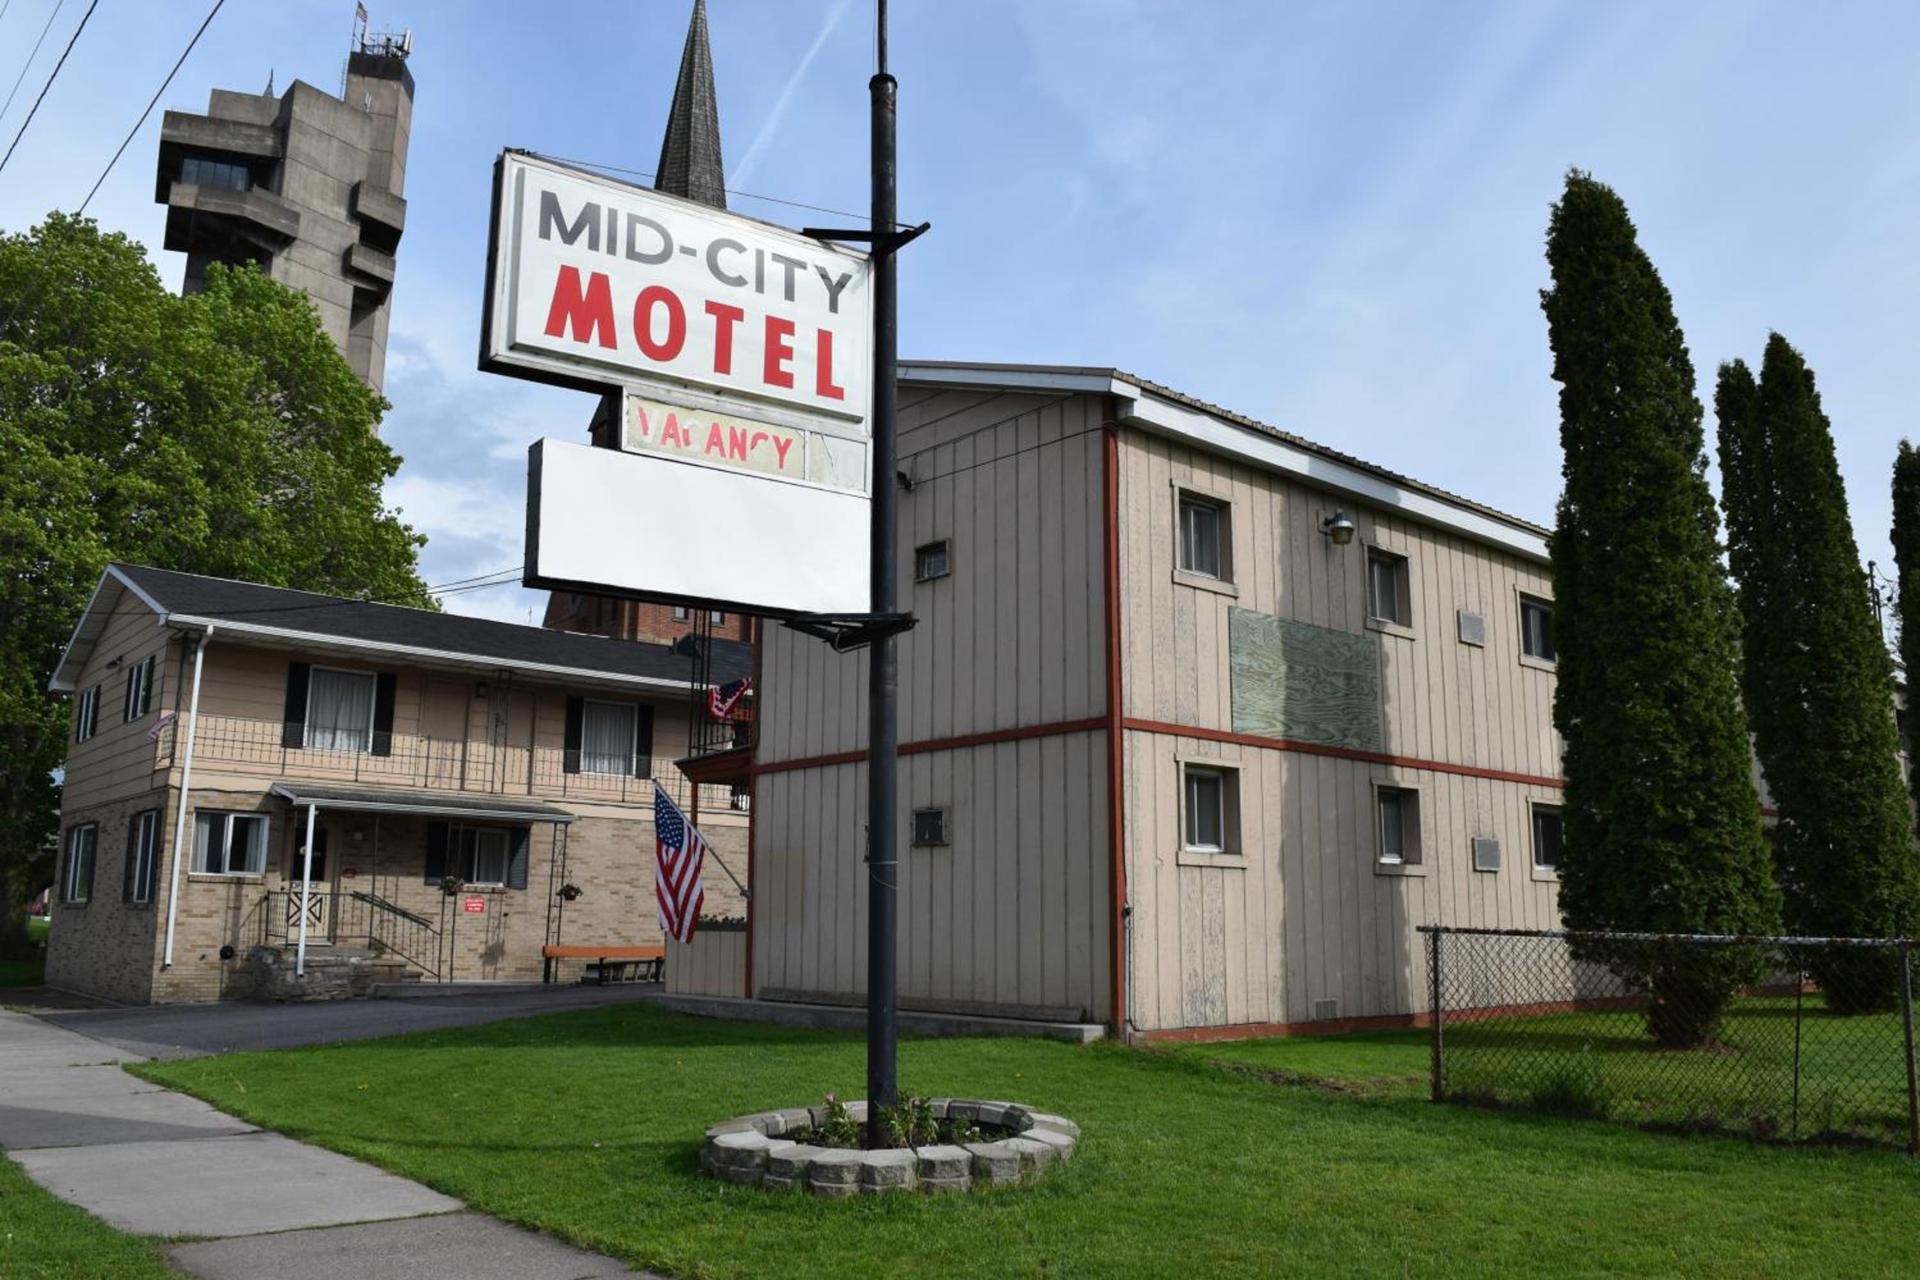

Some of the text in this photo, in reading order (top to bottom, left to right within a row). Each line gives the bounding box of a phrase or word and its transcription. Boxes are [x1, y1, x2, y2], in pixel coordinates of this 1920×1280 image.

[538, 189, 853, 314] MID-CITY
[545, 264, 845, 400] MOTEL
[638, 406, 793, 469] VAANY
